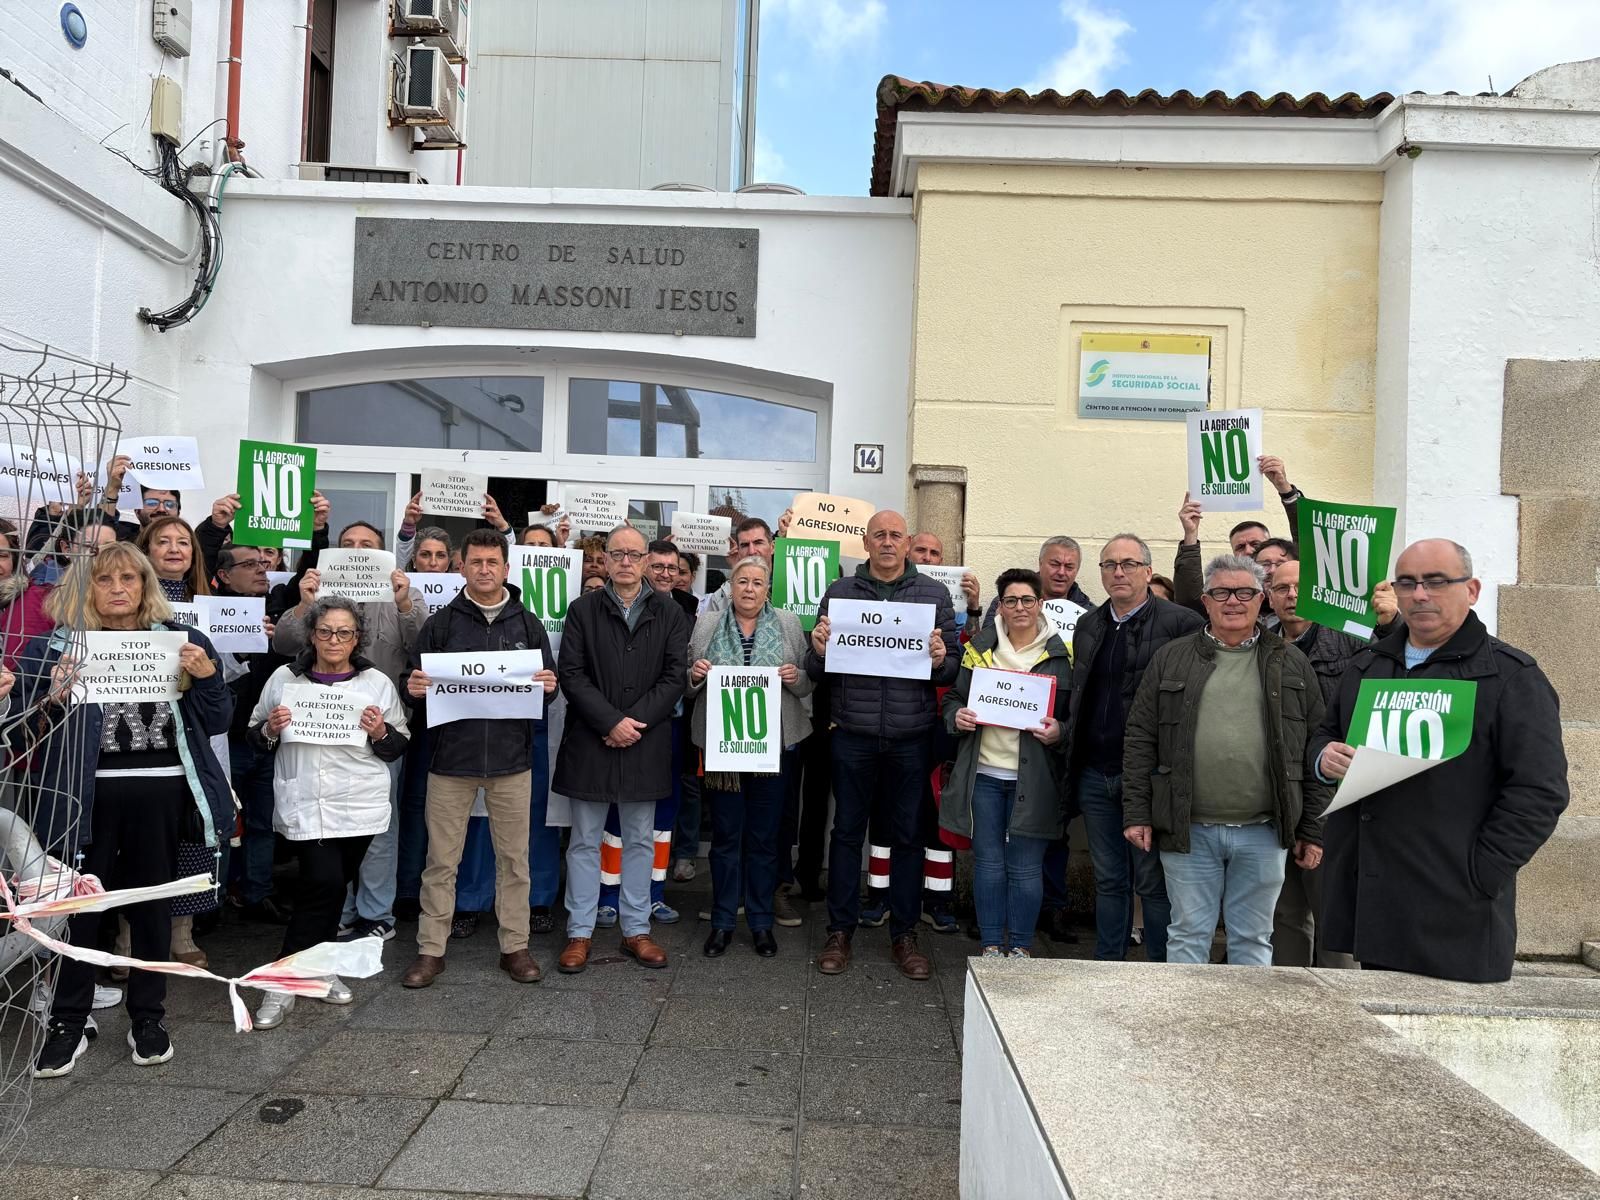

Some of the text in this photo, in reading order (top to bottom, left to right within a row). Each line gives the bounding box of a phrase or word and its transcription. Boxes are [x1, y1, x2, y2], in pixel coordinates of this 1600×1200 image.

[427, 242, 685, 266] CENTRO DE SALUD
[368, 280, 739, 312] ANTONIO MASSONI JESUS
[1112, 380, 1200, 390] SEGURIDAD SOCIAL
[1200, 416, 1250, 432] LA AGRESIÓN
[143, 446, 160, 454] NO
[1200, 428, 1250, 483] NO
[254, 449, 305, 467] LA AGRESIÓN
[860, 449, 876, 468] 14
[0, 467, 69, 483] AGRESIONES
[253, 463, 302, 518] NO
[431, 483, 474, 491] AGRESIONES
[1201, 482, 1250, 495] ES SOLUCIÓN
[425, 497, 481, 506] PROFESIONALES
[575, 498, 616, 506] AGRESIONES
[818, 502, 835, 513] NO
[432, 505, 474, 513] SANITARIOS
[569, 512, 622, 520] PROFESIONALES
[1312, 510, 1377, 534] LA AGRESIÓN
[248, 516, 300, 532] ES SOLUCIÓN
[575, 519, 615, 527] SANITARIOS
[797, 518, 866, 536] AGRESIONES
[786, 545, 829, 558] LA AGRESIÓN
[522, 554, 571, 569] LA AGRESIÓN
[1313, 526, 1369, 597] NO
[786, 556, 826, 604] NO
[424, 584, 443, 593] NO
[522, 567, 567, 619] NO
[1312, 586, 1368, 615] ES SOLUCIÓN
[221, 608, 236, 617] NO
[1045, 603, 1064, 614] NO
[174, 611, 198, 626] RESIÓN
[861, 613, 882, 625] NO
[210, 625, 261, 633] GRESIONES
[121, 641, 150, 650] STOP
[837, 634, 923, 651] AGRESIONES
[91, 652, 166, 661] AGRESIONES
[133, 663, 156, 672] LOS
[461, 664, 506, 676] NO +
[83, 674, 179, 683] PROFESIONALES
[721, 674, 768, 688] LA AGRESIÓN
[96, 686, 167, 695] SANITARIOS
[435, 684, 532, 695] AGRESIONES
[996, 681, 1011, 690] NO
[294, 701, 354, 711] AGRESIONES
[978, 695, 1038, 711] AGRESIONES
[1373, 690, 1452, 714] LA AGRESIÓN
[326, 712, 345, 720] LOS
[721, 687, 767, 741] NO
[291, 721, 362, 730] ROFESIONALES
[294, 729, 350, 738] SANITARIOS
[1366, 708, 1444, 760] NO
[720, 741, 767, 753] ES SOLUCIÓN
